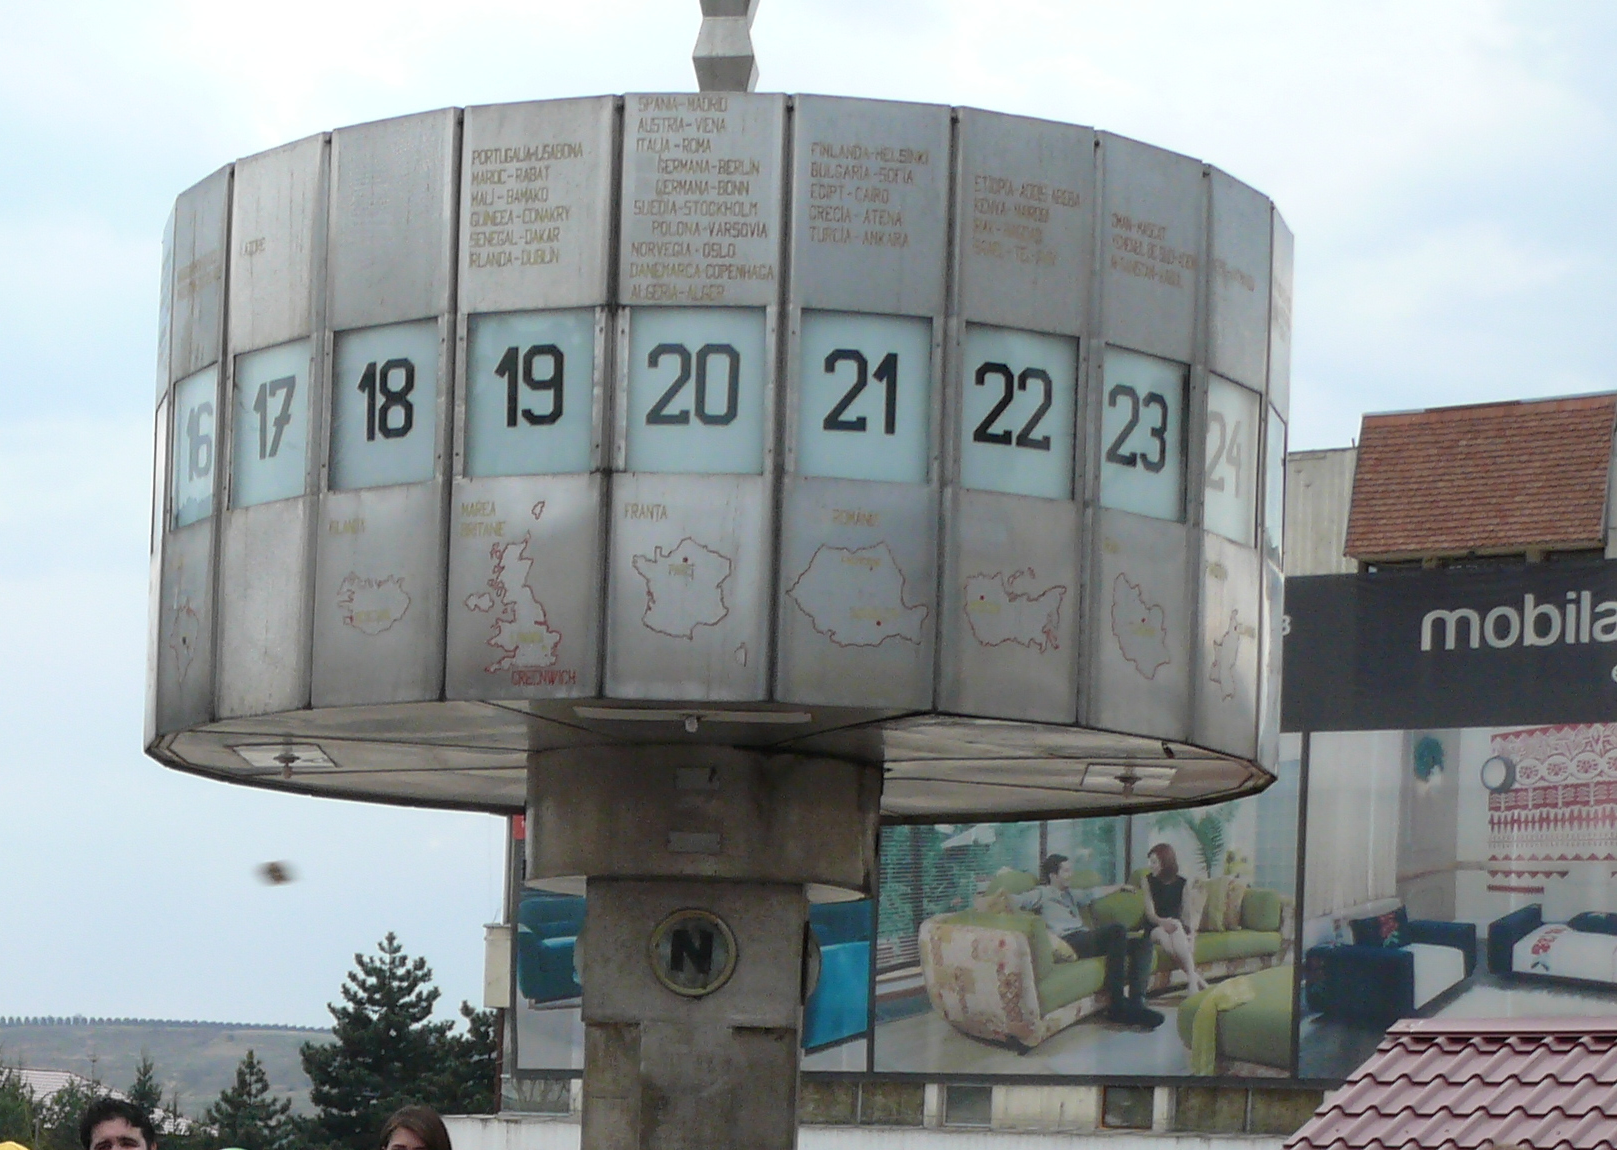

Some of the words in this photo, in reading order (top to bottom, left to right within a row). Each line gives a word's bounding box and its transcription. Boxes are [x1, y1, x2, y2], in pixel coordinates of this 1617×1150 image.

[253, 375, 297, 460] 17
[358, 358, 415, 442] 18
[494, 343, 565, 428] 19
[645, 343, 741, 427] 20
[823, 349, 898, 434] 21
[973, 362, 1053, 451] 22
[185, 401, 214, 482] 16
[1106, 384, 1169, 473] 23
[1205, 410, 1242, 498] 24
[669, 928, 714, 974] N
